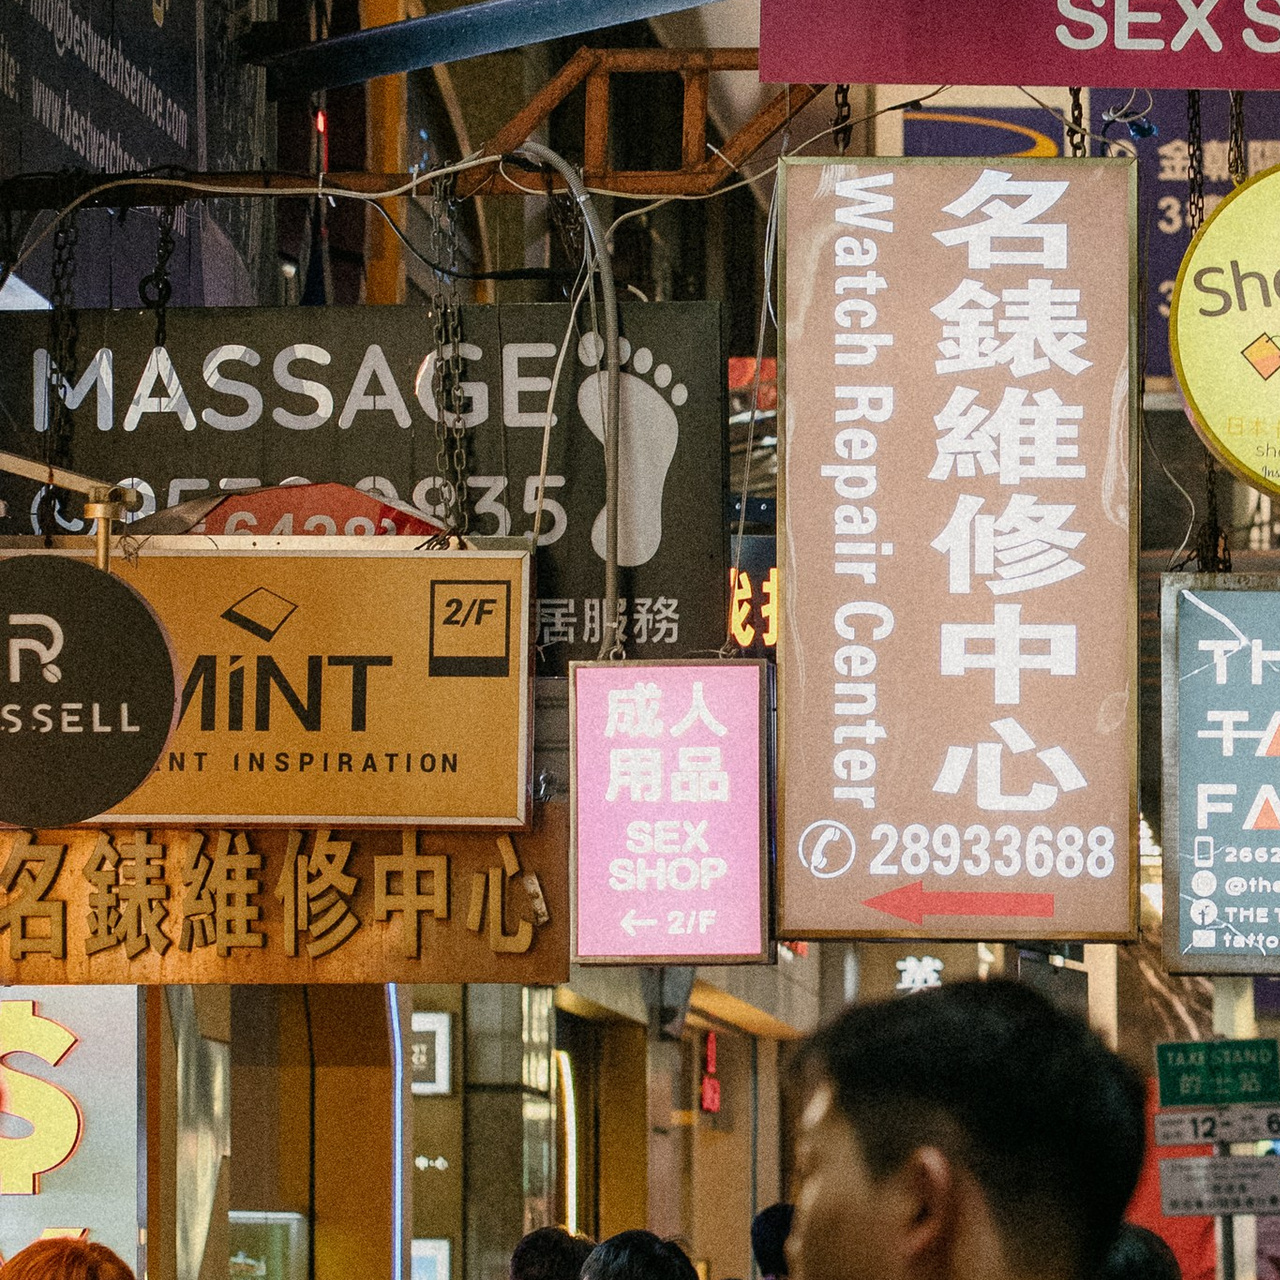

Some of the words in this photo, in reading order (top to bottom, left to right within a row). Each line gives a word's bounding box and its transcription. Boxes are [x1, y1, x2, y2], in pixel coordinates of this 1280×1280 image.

[832, 171, 895, 367] Watch
[33, 342, 558, 431] MASSAGE
[819, 385, 895, 585] Repair
[926, 167, 1095, 813] 名錶維修中心
[442, 597, 498, 626] 2/F
[604, 681, 728, 739] 成人
[831, 599, 895, 810] Center
[155, 752, 208, 772] NT
[233, 752, 458, 773] INSPIRATION
[604, 746, 729, 803] 用品
[625, 819, 710, 854] SEX
[869, 823, 1116, 880] 28933688
[0, 828, 549, 959] 名錶維修中心
[608, 857, 728, 891] SHOP
[666, 909, 717, 935] 2/F
[1224, 906, 1270, 924] THE
[1191, 1116, 1218, 1139] 12
